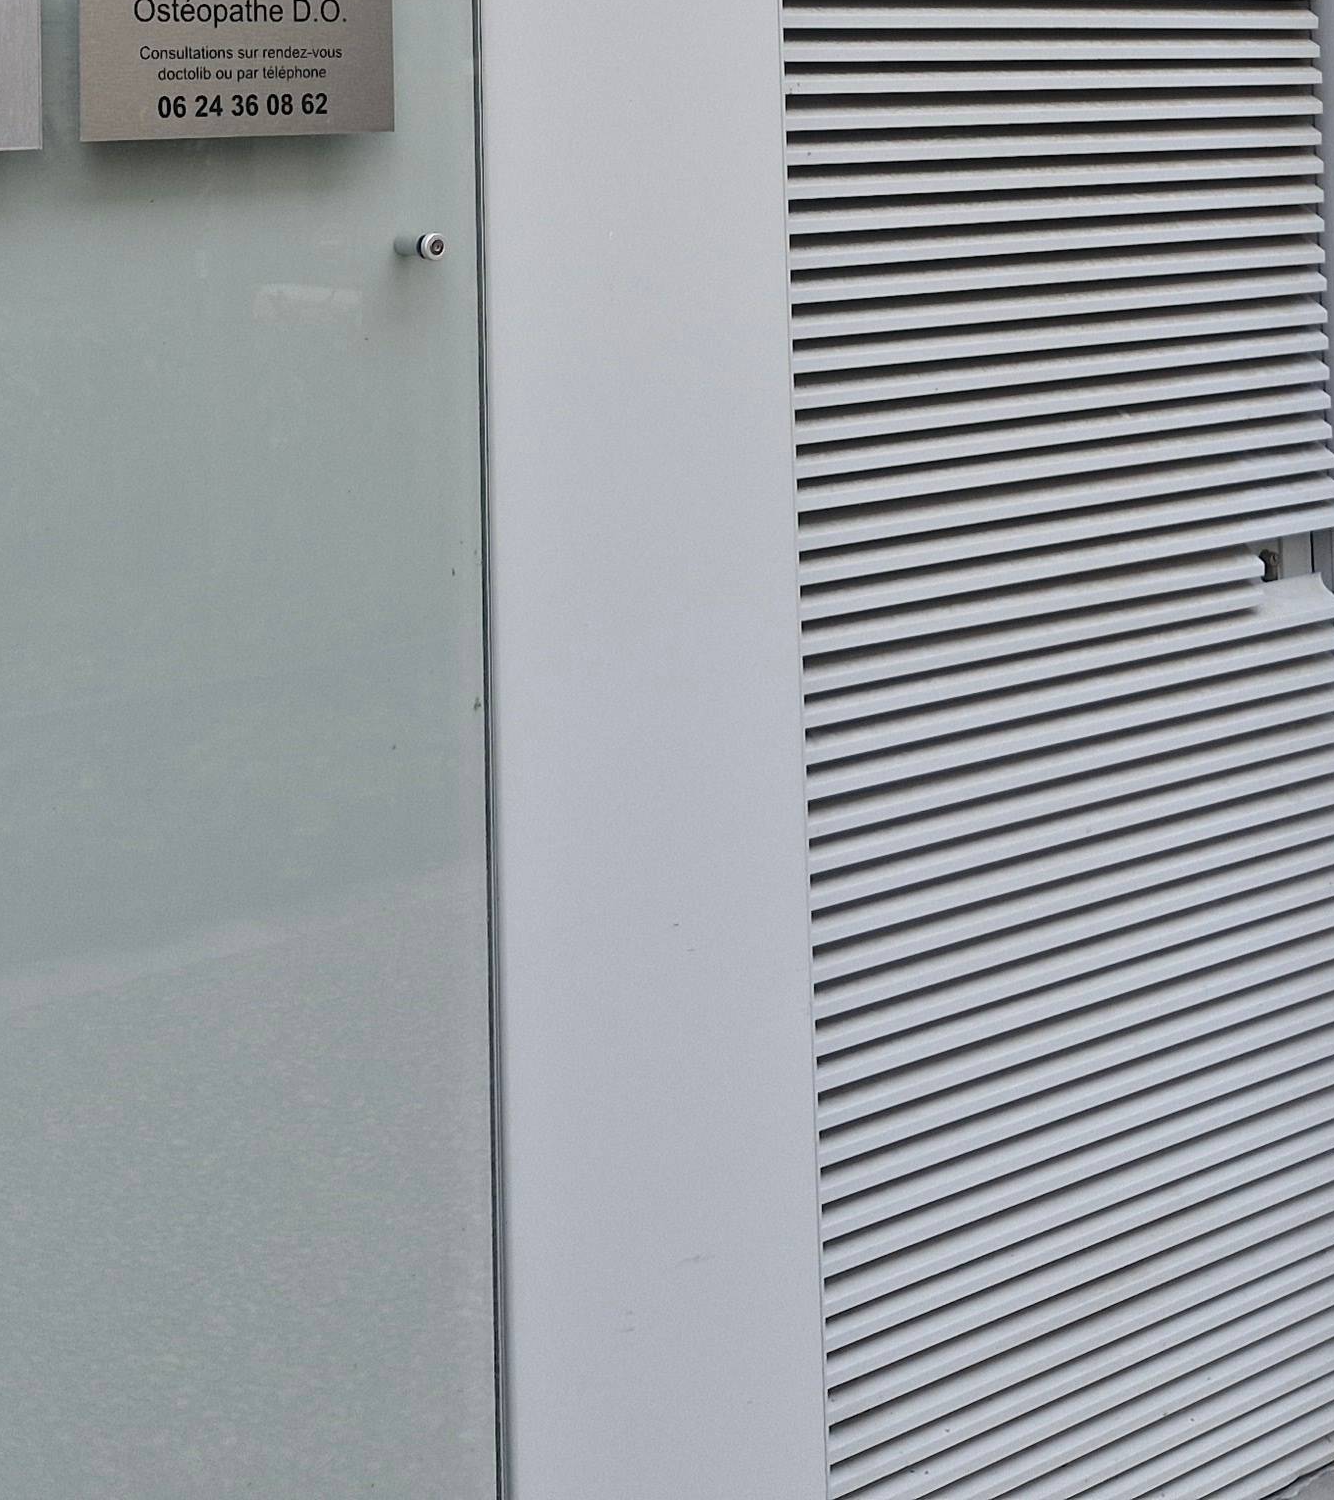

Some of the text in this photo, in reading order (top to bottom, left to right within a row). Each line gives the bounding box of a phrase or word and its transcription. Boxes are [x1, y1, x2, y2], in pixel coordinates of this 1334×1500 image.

[140, 46, 342, 60] Consultations sur rendez-vous
[158, 66, 326, 82] doctolib ou par téléphone
[158, 93, 327, 118] 06 24 36 08 62
